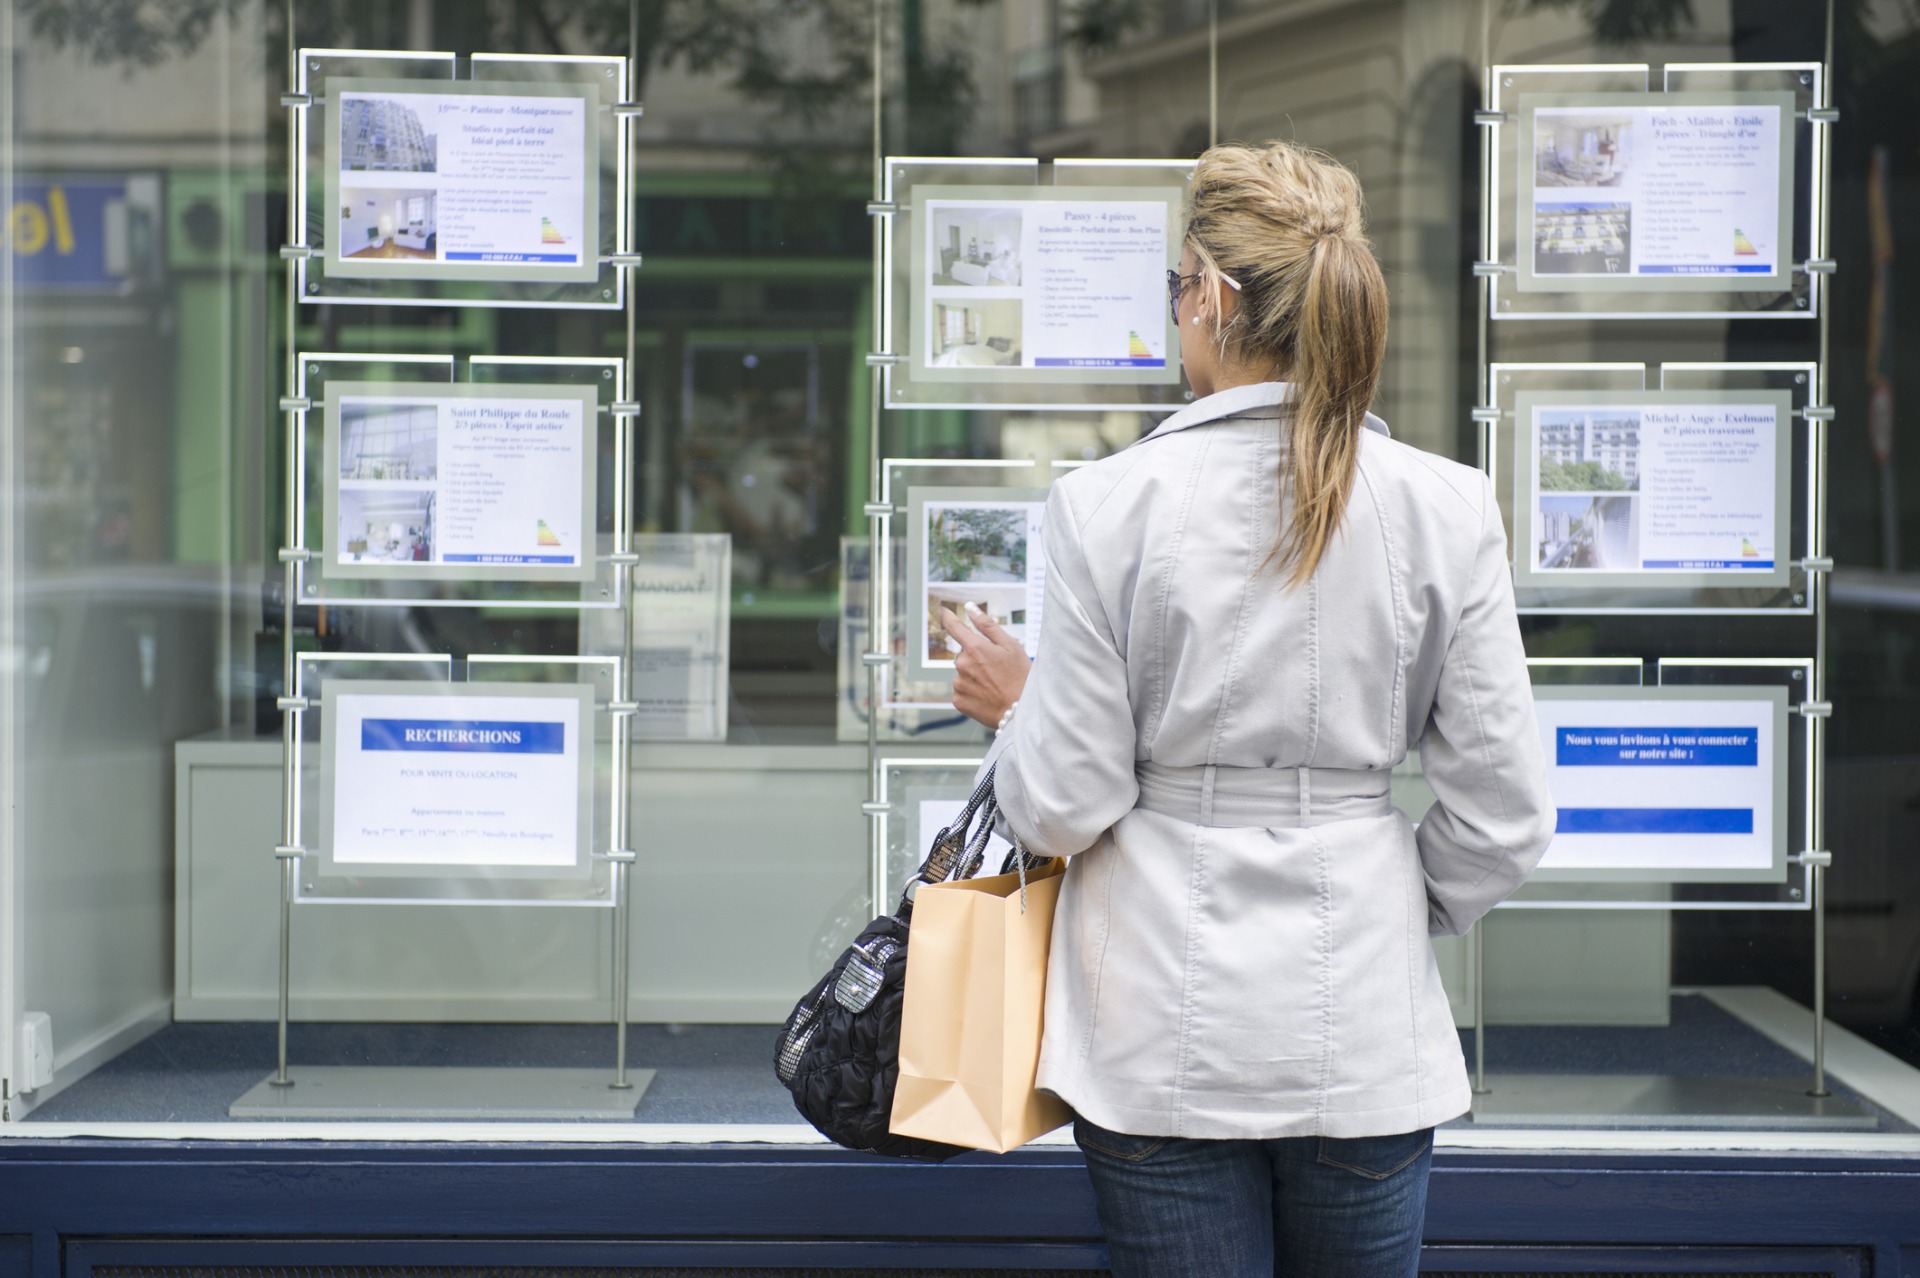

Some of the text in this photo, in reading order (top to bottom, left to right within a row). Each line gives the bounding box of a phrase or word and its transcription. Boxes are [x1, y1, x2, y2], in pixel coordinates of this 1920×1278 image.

[470, 106, 505, 114] Pasteur
[1652, 117, 1676, 127] Foch
[1687, 117, 1723, 127] Maillot
[1735, 117, 1763, 127] Etoile
[462, 124, 490, 133] Studio
[505, 126, 535, 135] parfait
[537, 126, 554, 134] état
[1663, 131, 1689, 139] pièces
[1699, 131, 1735, 139] Triangle
[1738, 131, 1757, 139] d'or
[471, 137, 493, 145] Idéal
[496, 138, 514, 146] pied
[1064, 211, 1091, 222] Passy
[1109, 212, 1136, 222] pièces
[451, 408, 570, 420] Saint Philippe du Roule
[1645, 414, 1679, 423] Michel
[1689, 415, 1714, 425] Ange
[1725, 414, 1774, 423] Exelmans
[455, 420, 468, 429] 2/3
[471, 421, 497, 430] pièces
[505, 421, 532, 431] Esprit
[535, 422, 564, 430] atelier
[1679, 427, 1705, 436] pièces
[405, 728, 522, 744] RECHERCHONS
[1565, 734, 1749, 746] Nous vous invitons à vous connecter
[1620, 749, 1637, 759] sur
[1639, 749, 1667, 759] notre
[1669, 748, 1687, 759] site
[400, 769, 424, 777] POUR
[426, 770, 453, 778] VENTE
[472, 771, 517, 779] LOCATION
